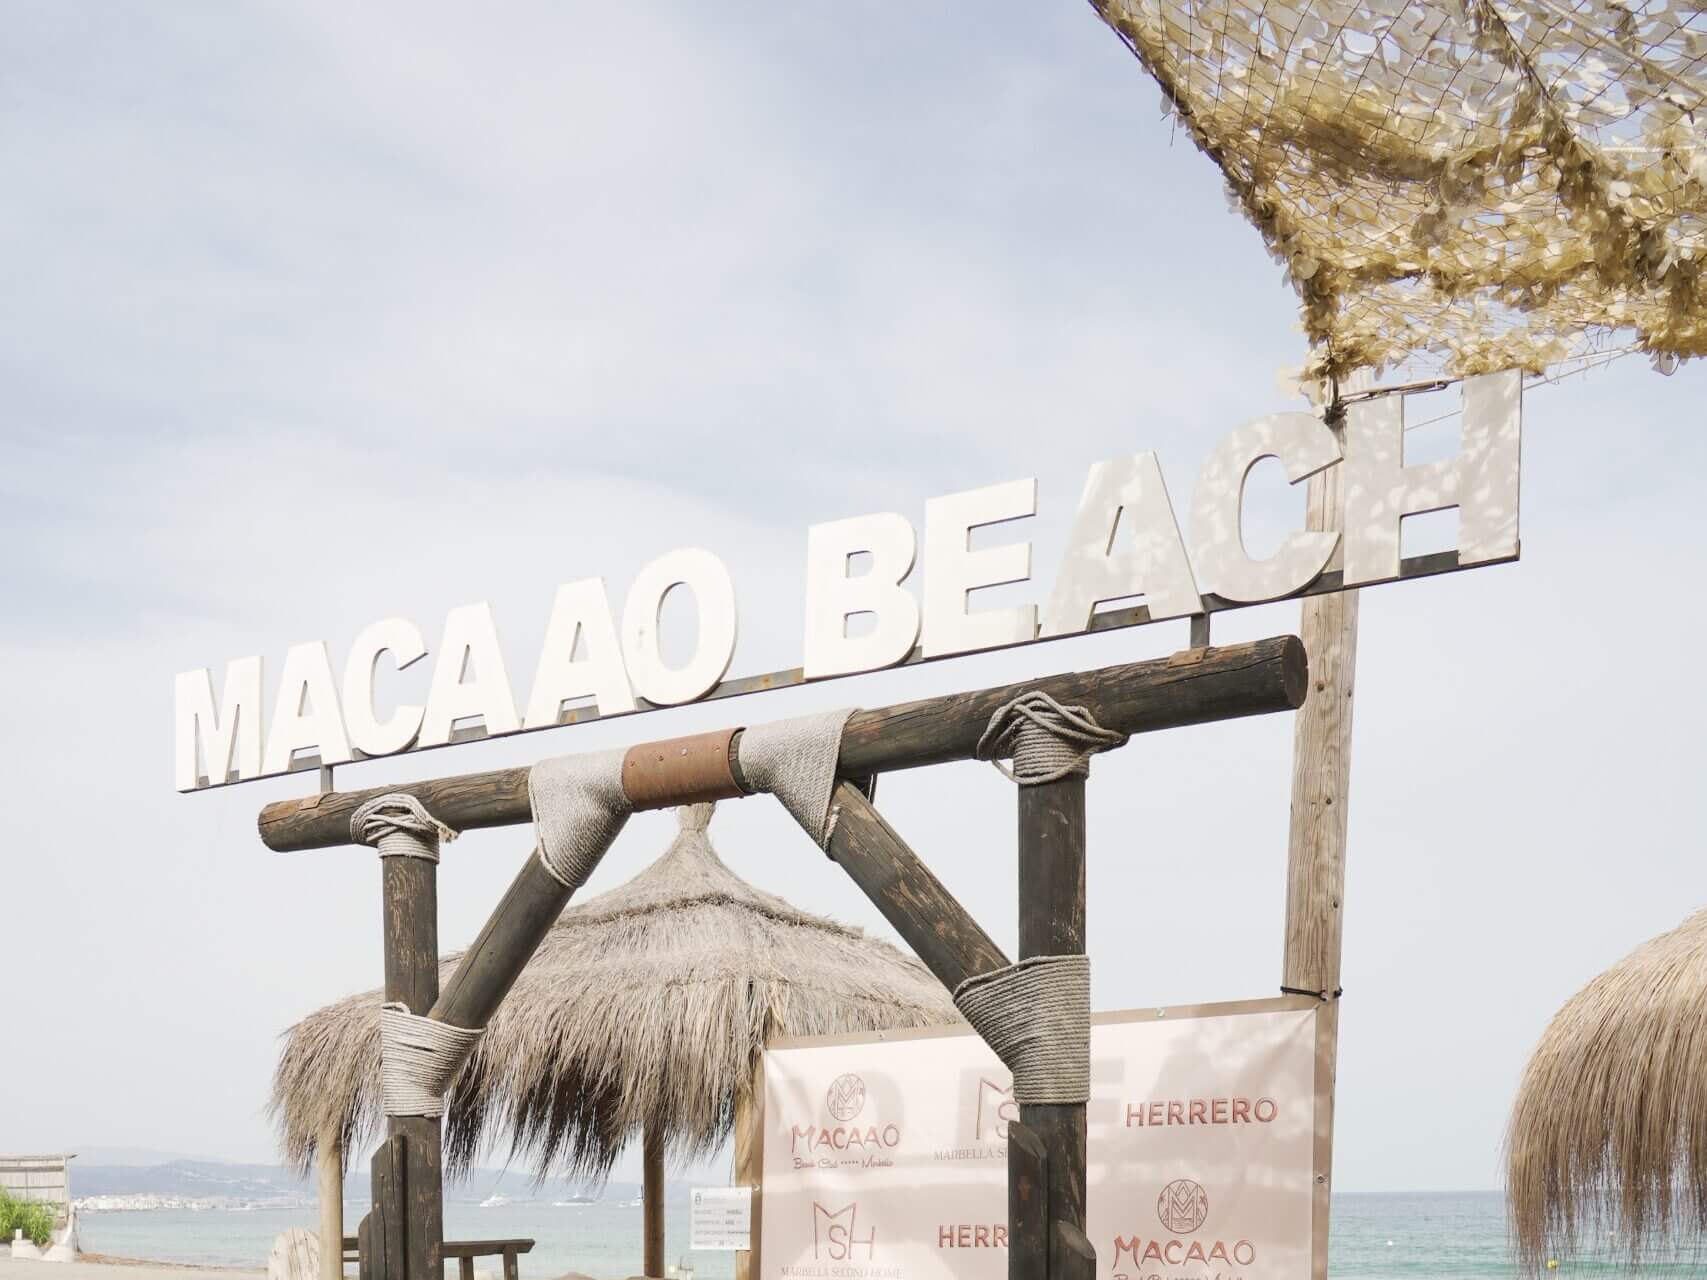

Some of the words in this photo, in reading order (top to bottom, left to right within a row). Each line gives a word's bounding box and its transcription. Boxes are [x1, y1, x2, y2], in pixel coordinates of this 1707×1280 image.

[175, 546, 737, 792] MACAAO
[802, 368, 1521, 681] BEACH
[1126, 1097, 1279, 1127] HERRERO
[792, 1123, 900, 1153] MACAAO
[938, 1224, 1009, 1248] HERR
[1112, 1235, 1256, 1270] MACAAO
